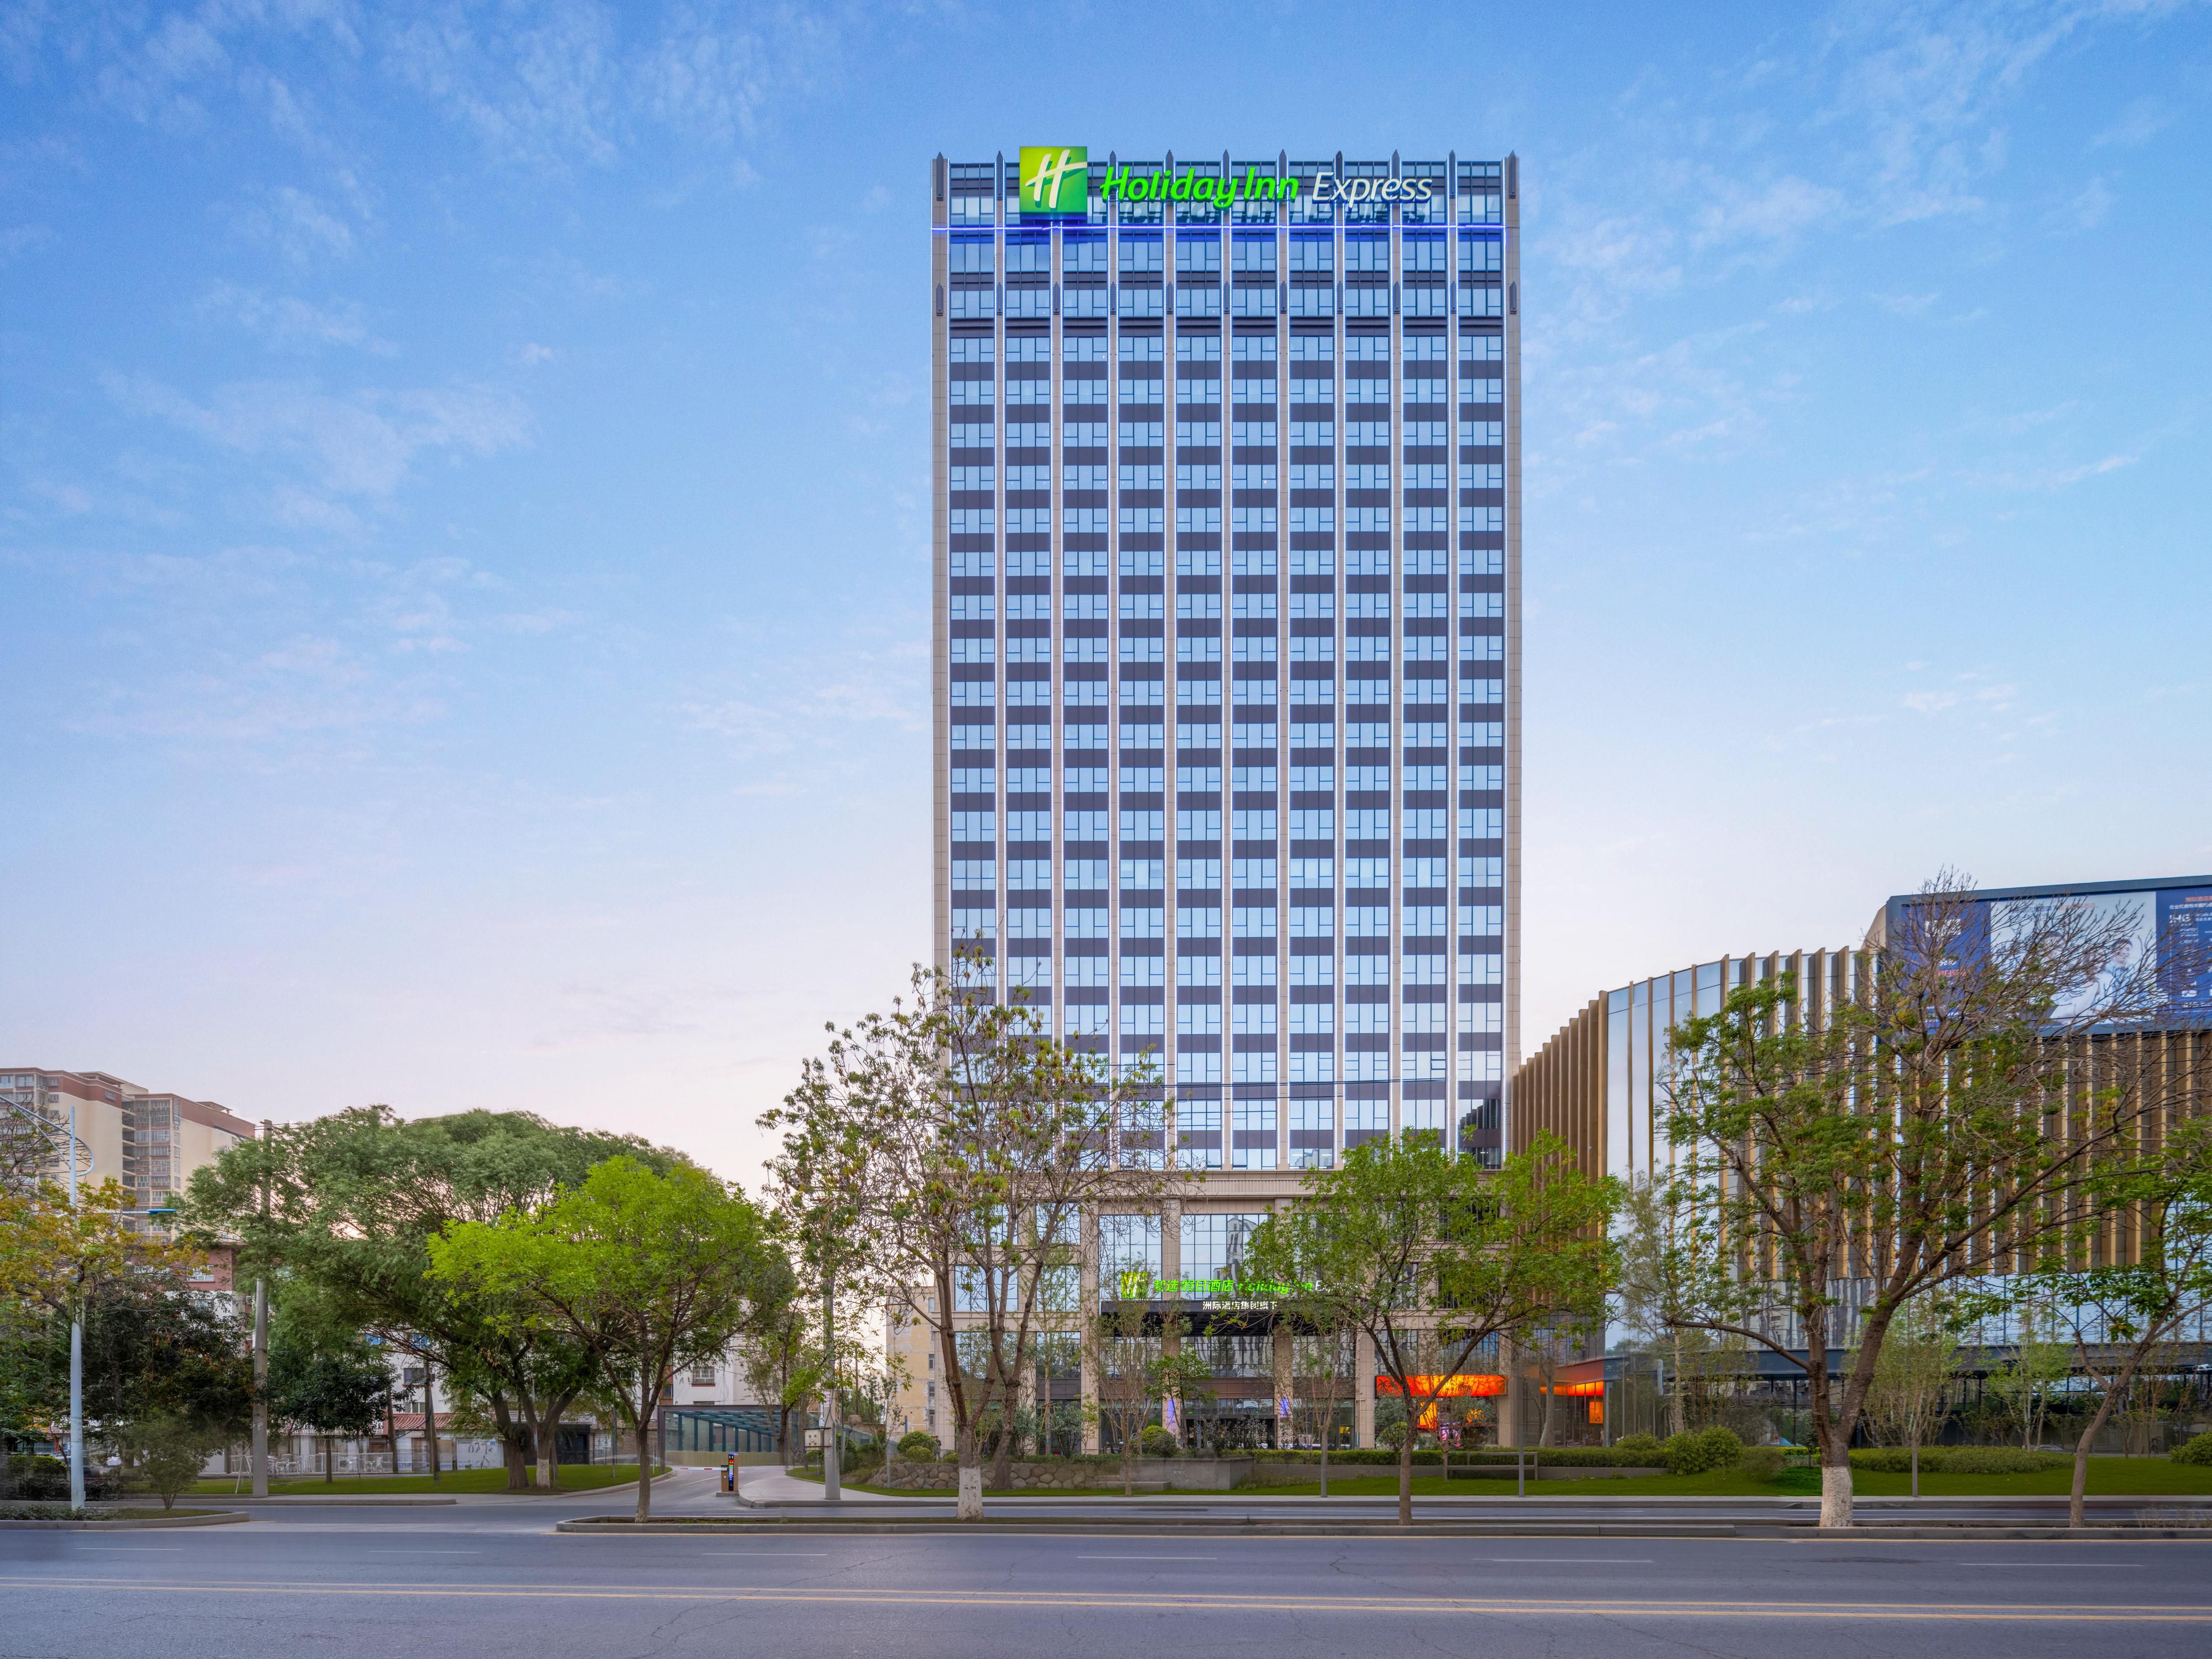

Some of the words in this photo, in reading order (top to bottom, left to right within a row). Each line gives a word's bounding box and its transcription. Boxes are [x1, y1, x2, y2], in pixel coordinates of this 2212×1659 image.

[1099, 166, 1238, 208] Holiday
[1244, 166, 1299, 200] Inn
[1313, 172, 1432, 208] Express
[1154, 1279, 1234, 1292] 智选假日酒店
[1203, 1301, 1278, 1310] 洲际酒店集团旗下
